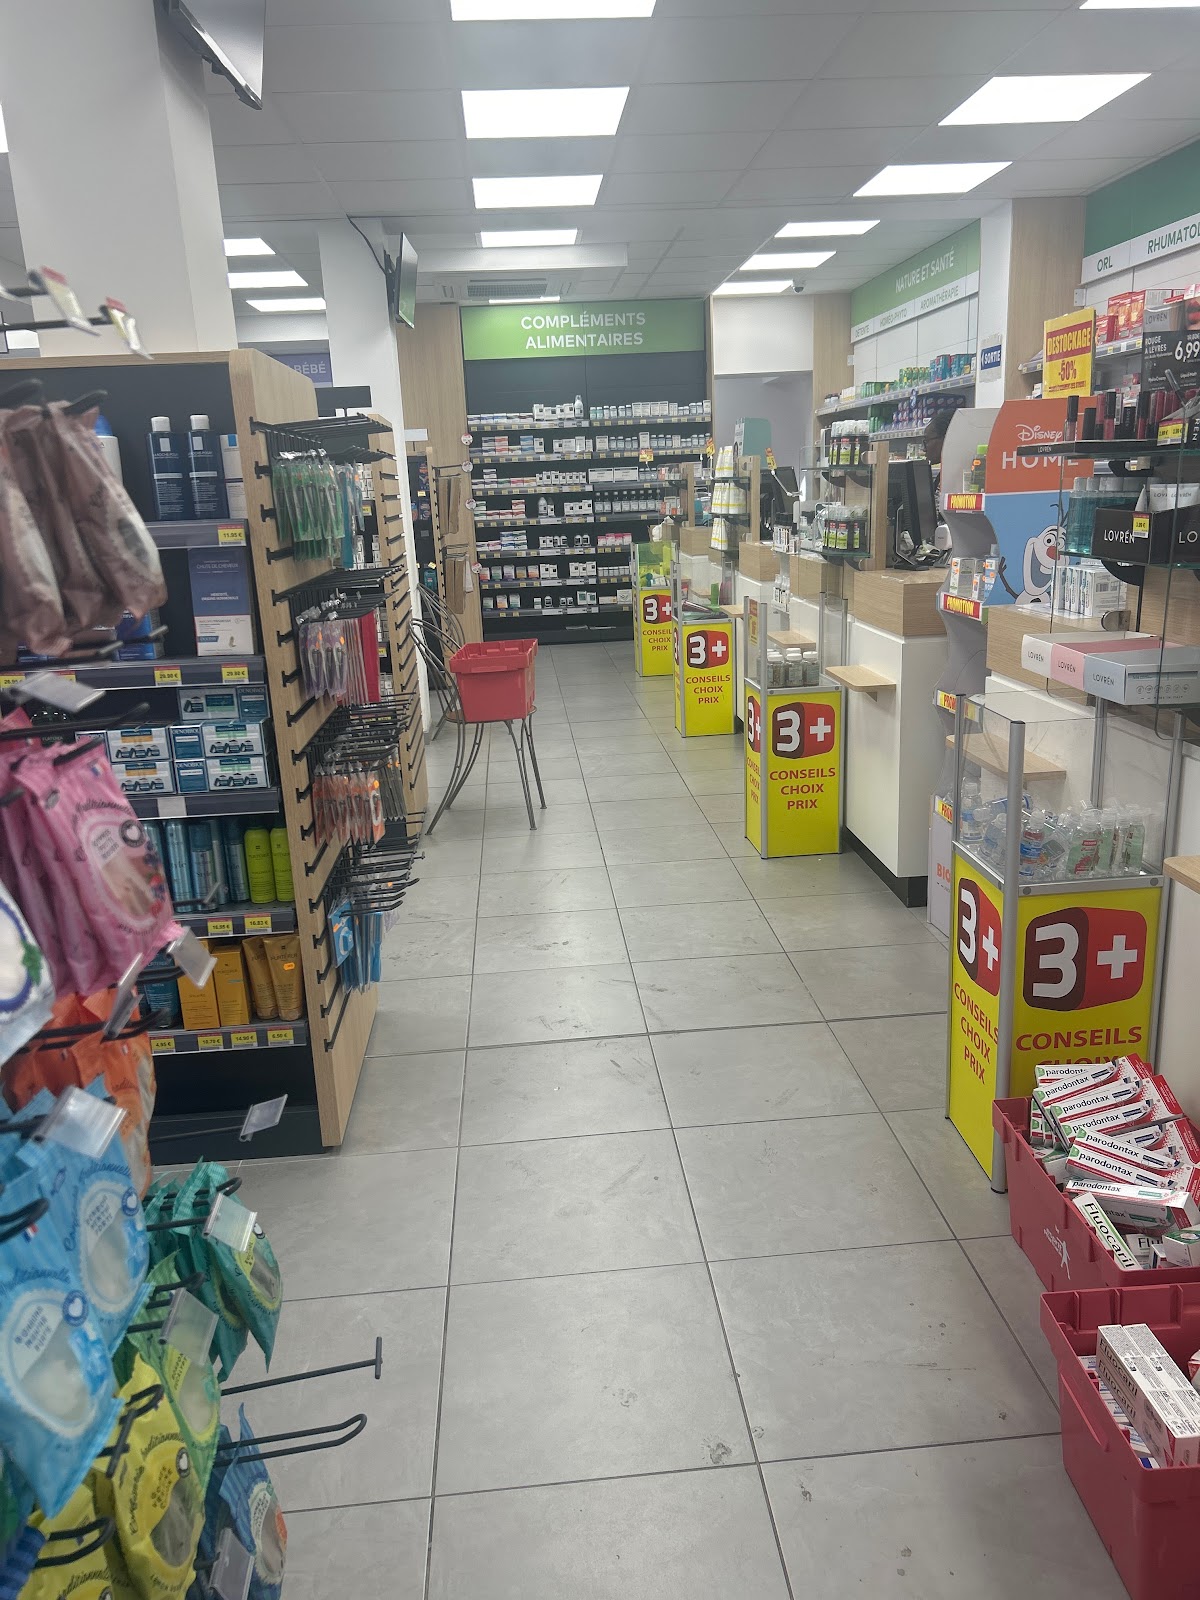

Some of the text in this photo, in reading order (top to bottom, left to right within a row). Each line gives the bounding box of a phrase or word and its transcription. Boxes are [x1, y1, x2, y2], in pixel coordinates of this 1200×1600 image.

[895, 246, 955, 294] NATURE ET SANTÉ
[1096, 256, 1113, 273] ORL
[521, 311, 646, 330] COMPLÉMENTS
[525, 332, 643, 350] ALIMENTAIRES
[1047, 327, 1091, 356] DESTOCKAGE
[984, 350, 1001, 365] SORTIE
[294, 361, 326, 375] BÉBÉ
[1058, 360, 1077, 381] -50%
[950, 494, 977, 509] PROMOTION
[1103, 529, 1135, 543] LOVRÉN
[946, 595, 975, 615] PROMOTION
[1027, 651, 1044, 663] LOVRÉN
[1057, 659, 1077, 674] LOVRÉN
[685, 673, 731, 685] CONSEILS
[1092, 672, 1115, 687] LOVRÉN
[693, 685, 724, 694] CHOIX
[698, 696, 720, 704] PRIX
[769, 766, 836, 781] CONSEILS
[780, 783, 824, 796] CHOIX
[787, 798, 818, 810] PRIX
[954, 982, 999, 1046] CONSEILS
[960, 1016, 991, 1065] CHOIX
[1015, 1026, 1142, 1051] CONSEILS
[964, 1045, 986, 1085] PRIX
[1045, 1076, 1090, 1098] parodontax
[1062, 1095, 1110, 1115] parodontax
[1085, 1134, 1140, 1158] parodontax
[1078, 1152, 1133, 1177] parodontax
[1072, 1180, 1122, 1193] parodontax
[1084, 1202, 1135, 1269] Fluocaril
